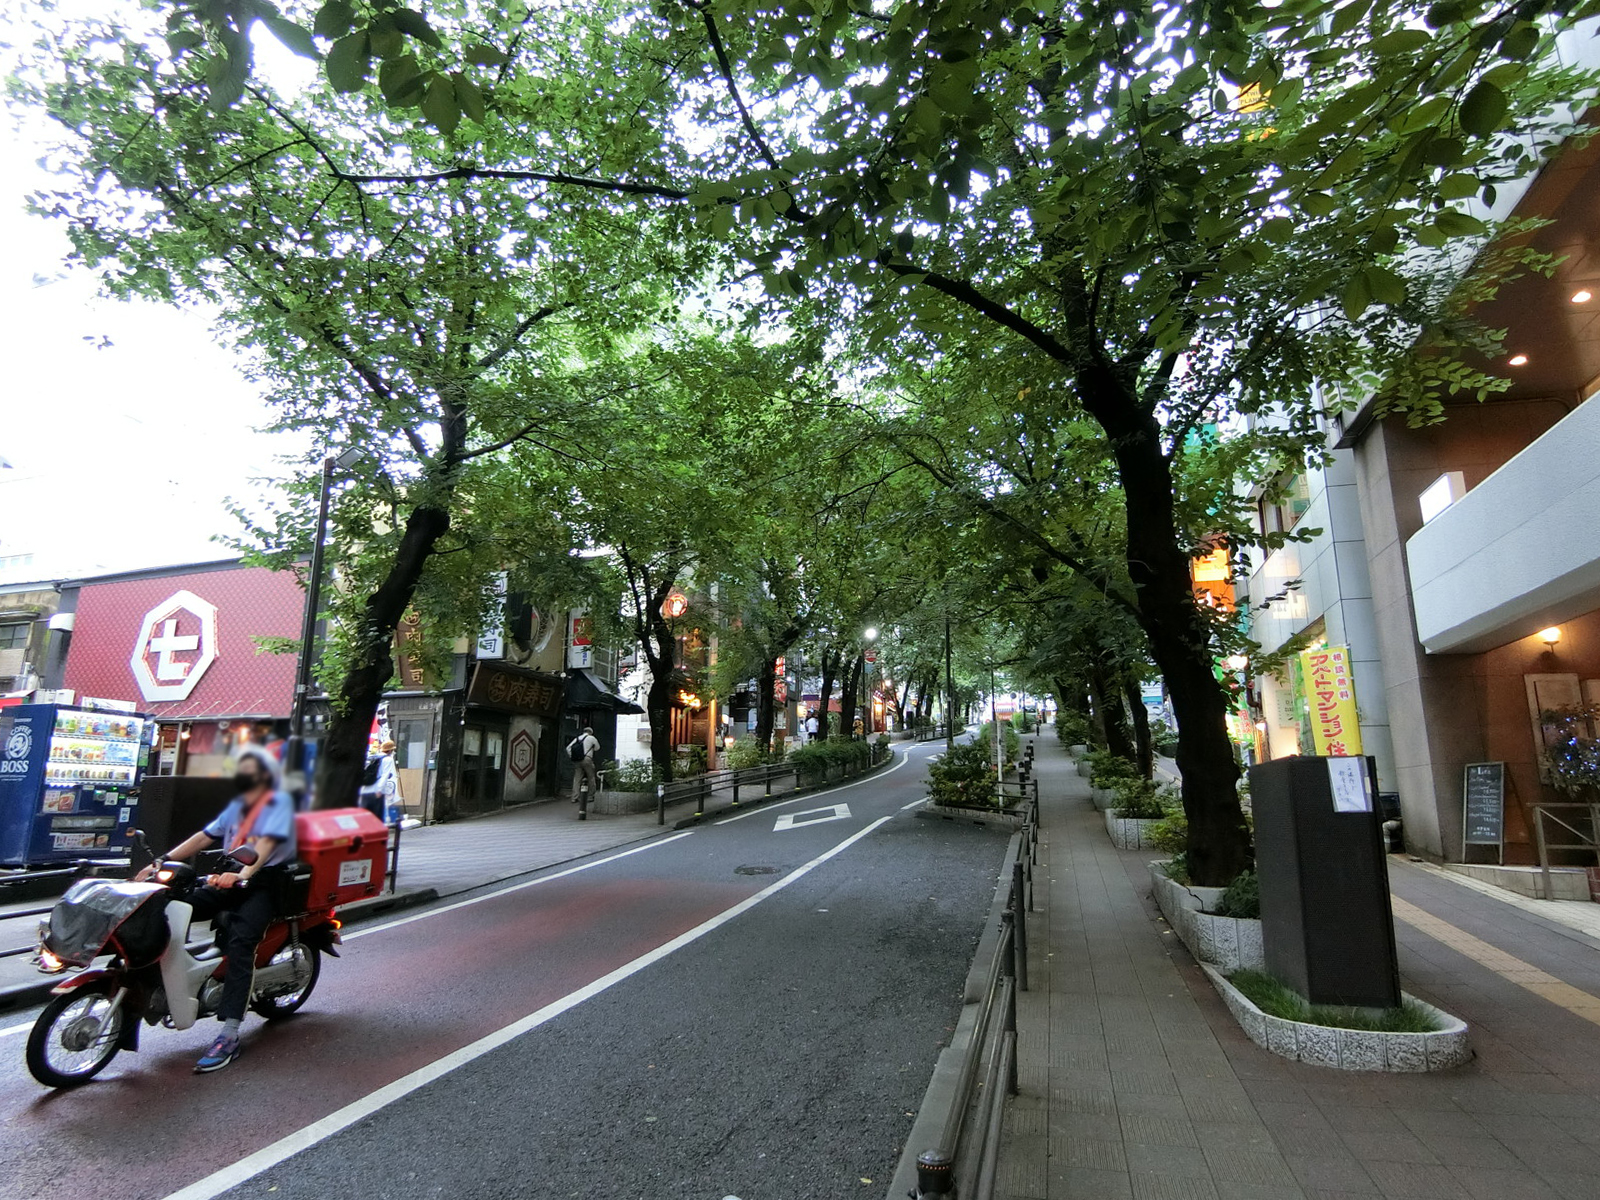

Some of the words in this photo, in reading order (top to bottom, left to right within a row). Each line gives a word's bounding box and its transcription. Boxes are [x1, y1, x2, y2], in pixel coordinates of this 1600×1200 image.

[1332, 653, 1349, 699] 相談無料
[508, 677, 555, 710] 肉寿司
[10, 725, 33, 736] COFFEE
[0, 760, 29, 773] BOSS
